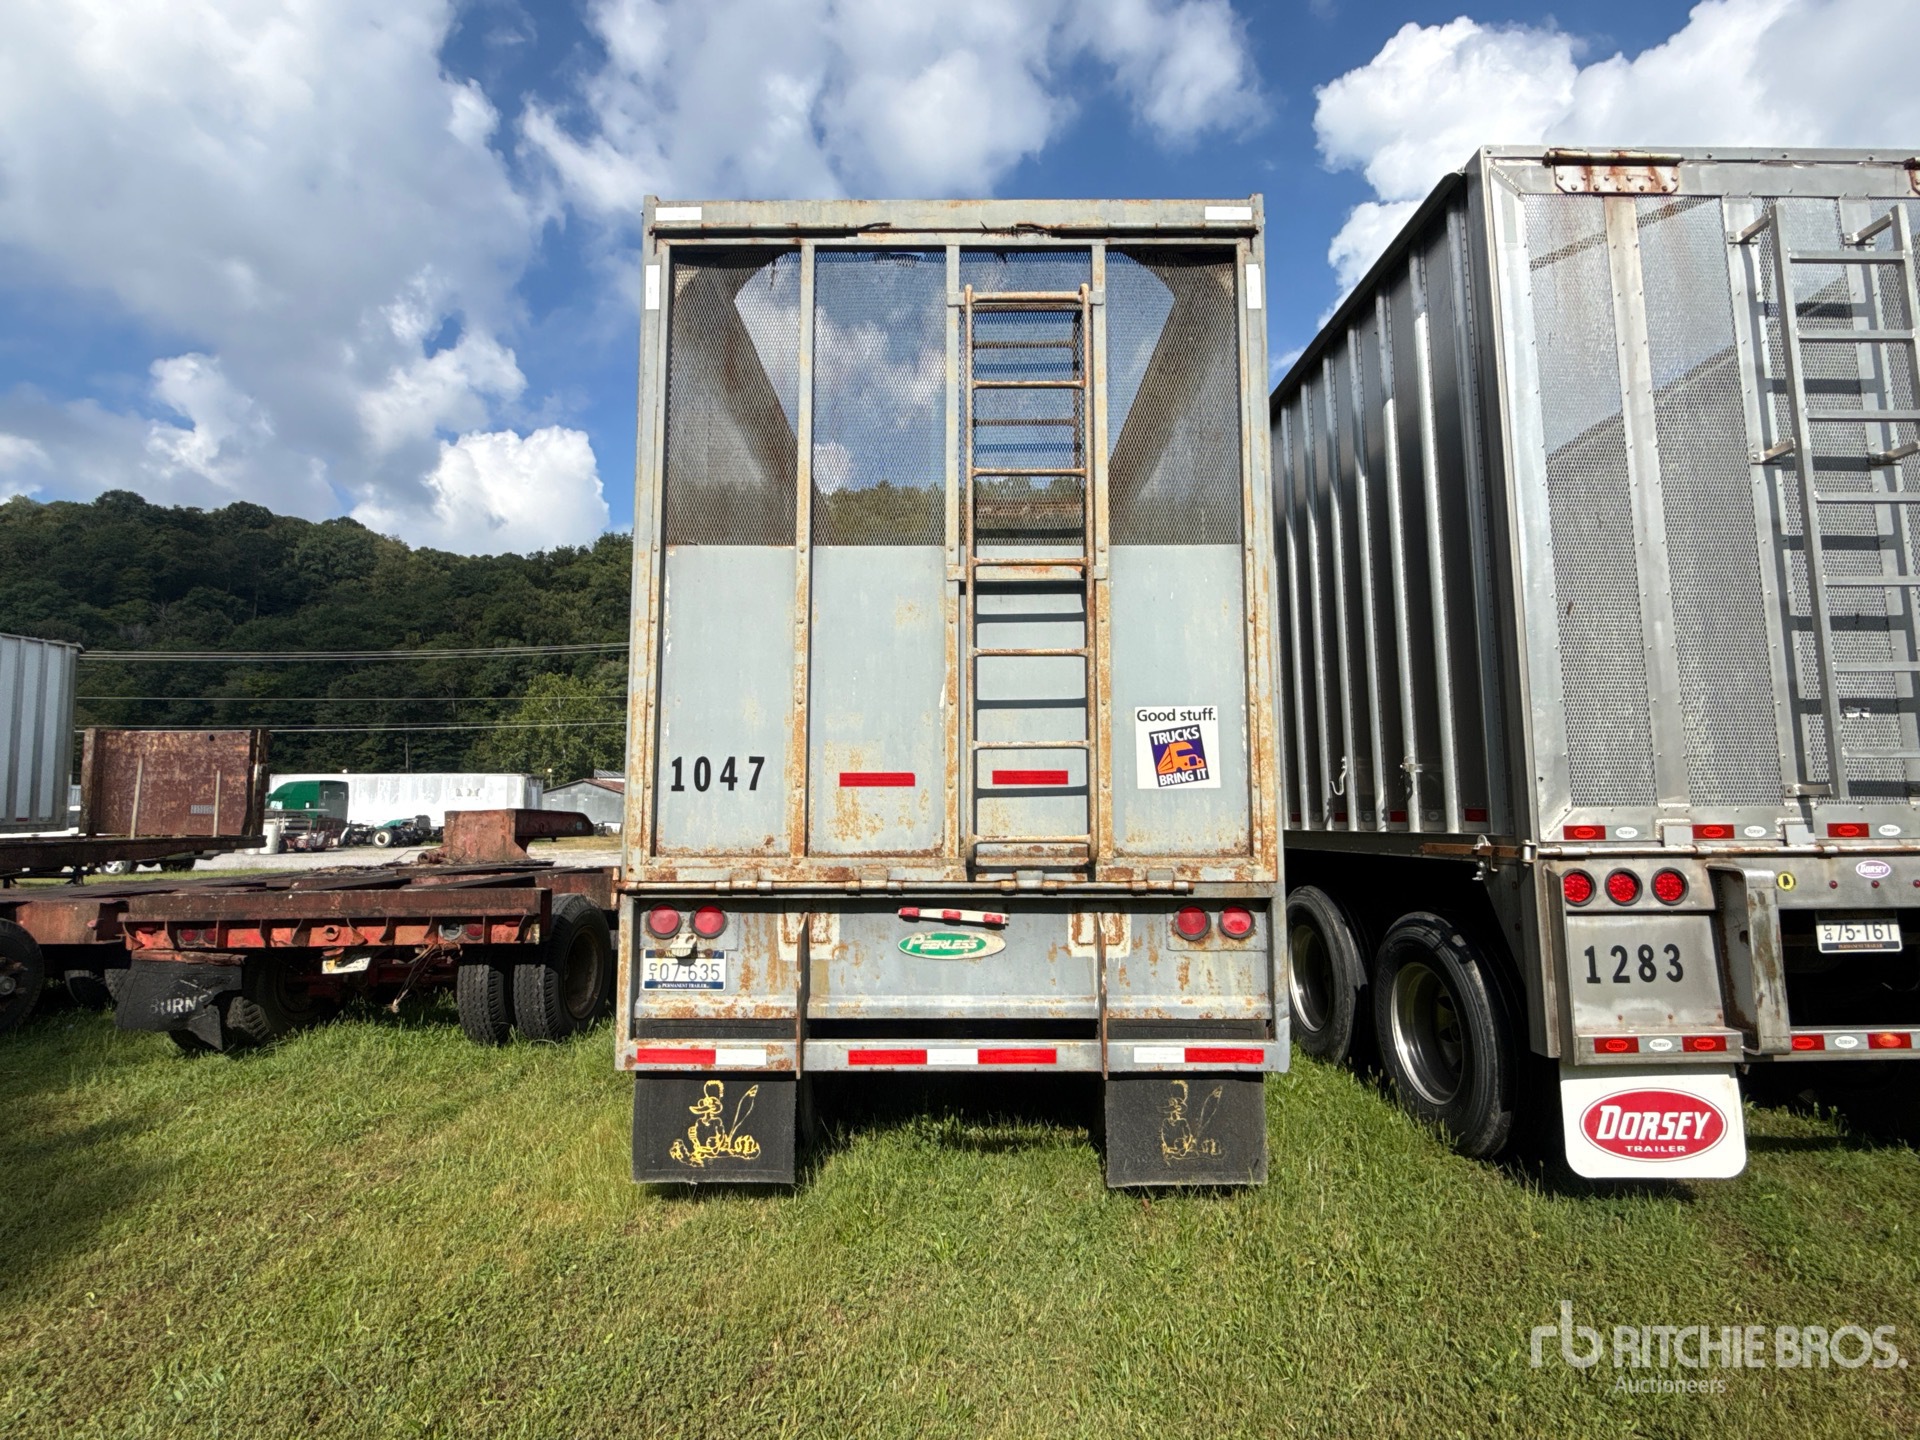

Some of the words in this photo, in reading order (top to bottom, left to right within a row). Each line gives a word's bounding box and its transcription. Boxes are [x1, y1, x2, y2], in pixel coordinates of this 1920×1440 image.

[1136, 708, 1176, 721] Good
[1179, 707, 1216, 721] stuff.
[1151, 727, 1200, 745] TRUCKS
[670, 756, 766, 792] 1047
[1159, 770, 1194, 786] BRING
[1197, 768, 1208, 780] IT
[1860, 864, 1887, 873] DORSEY
[1583, 943, 1685, 984] 1283
[1596, 1104, 1712, 1141] DORSEY
[1625, 1144, 1687, 1153] TRAILER
